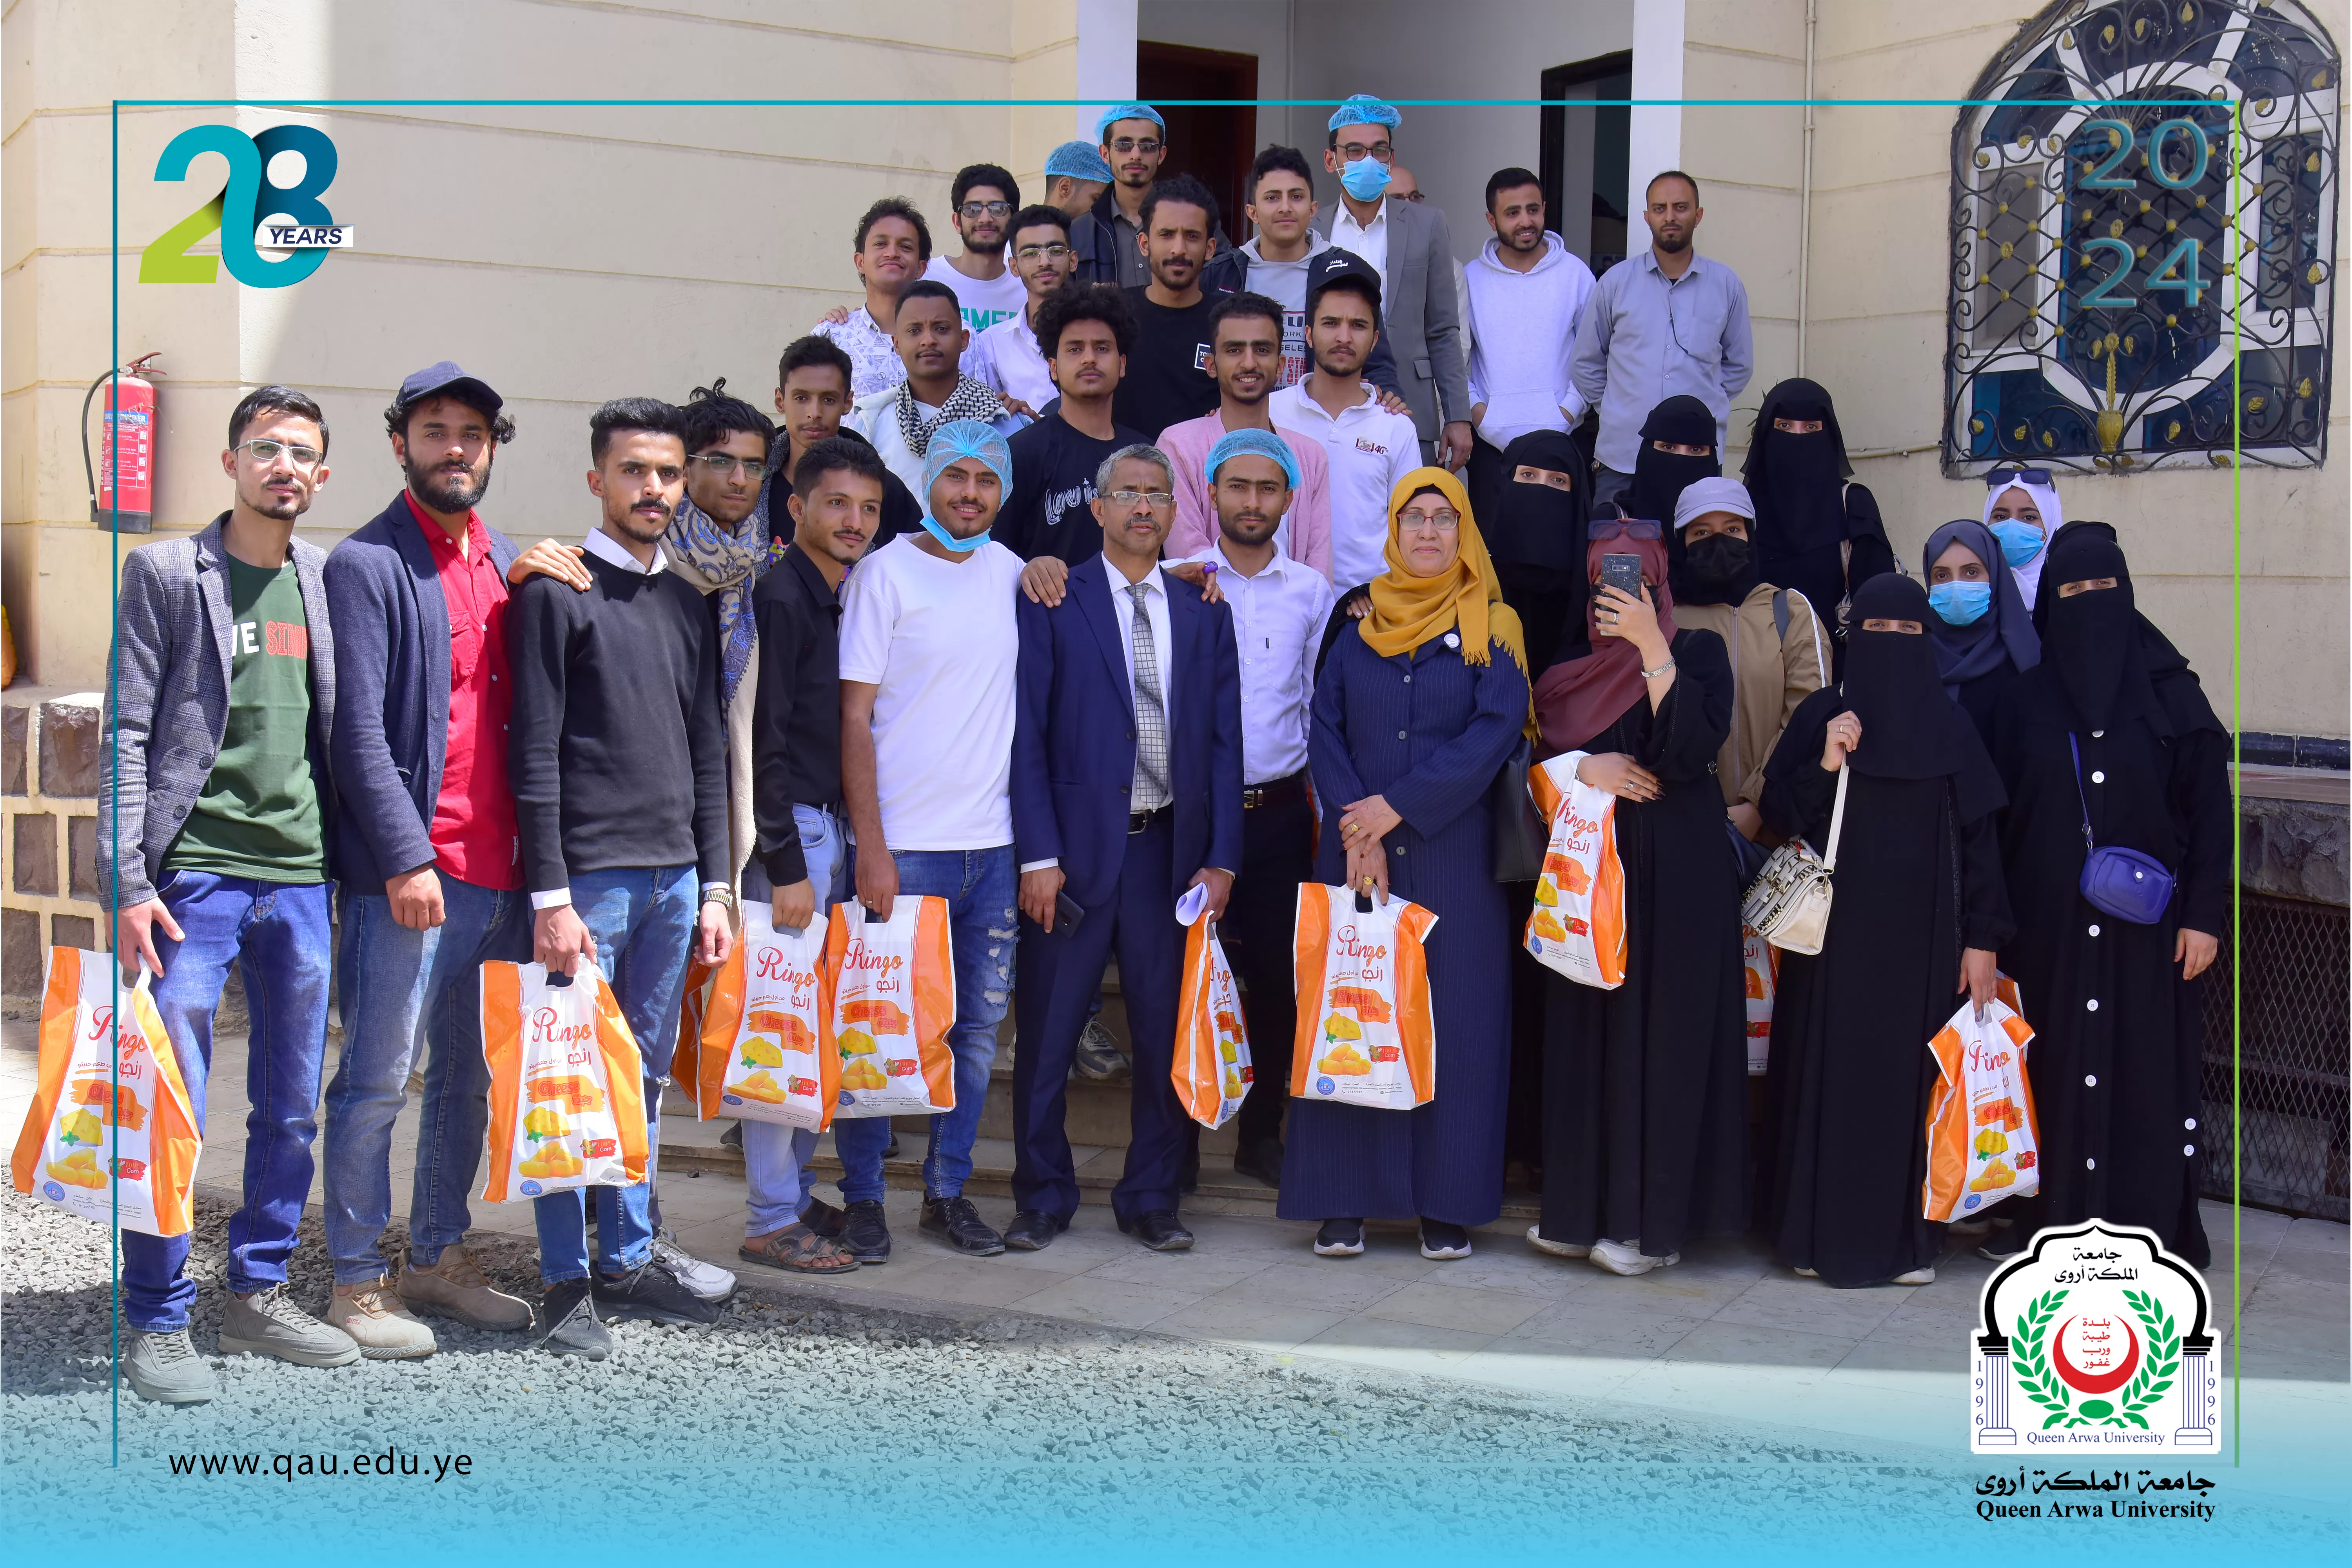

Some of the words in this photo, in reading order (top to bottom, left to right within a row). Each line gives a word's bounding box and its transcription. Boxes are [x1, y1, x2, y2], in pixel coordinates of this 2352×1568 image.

[1567, 838, 1590, 855] رنجو
[1336, 925, 1387, 967] Ringo
[845, 938, 904, 978] Ringo
[757, 946, 815, 994] Ringo
[1362, 966, 1383, 982] رنجو
[877, 977, 899, 993] رنجو
[791, 994, 810, 1011] رنجو
[1336, 989, 1370, 1005] Cheese
[851, 1004, 887, 1018] Cheese
[532, 1007, 592, 1051] Ringo
[760, 1013, 797, 1031] Cheese
[877, 1018, 898, 1029] جبنة
[568, 1048, 592, 1067] رنجو
[119, 1060, 142, 1080] رنجو
[538, 1081, 580, 1096] Cheese
[572, 1094, 593, 1107] جبنة
